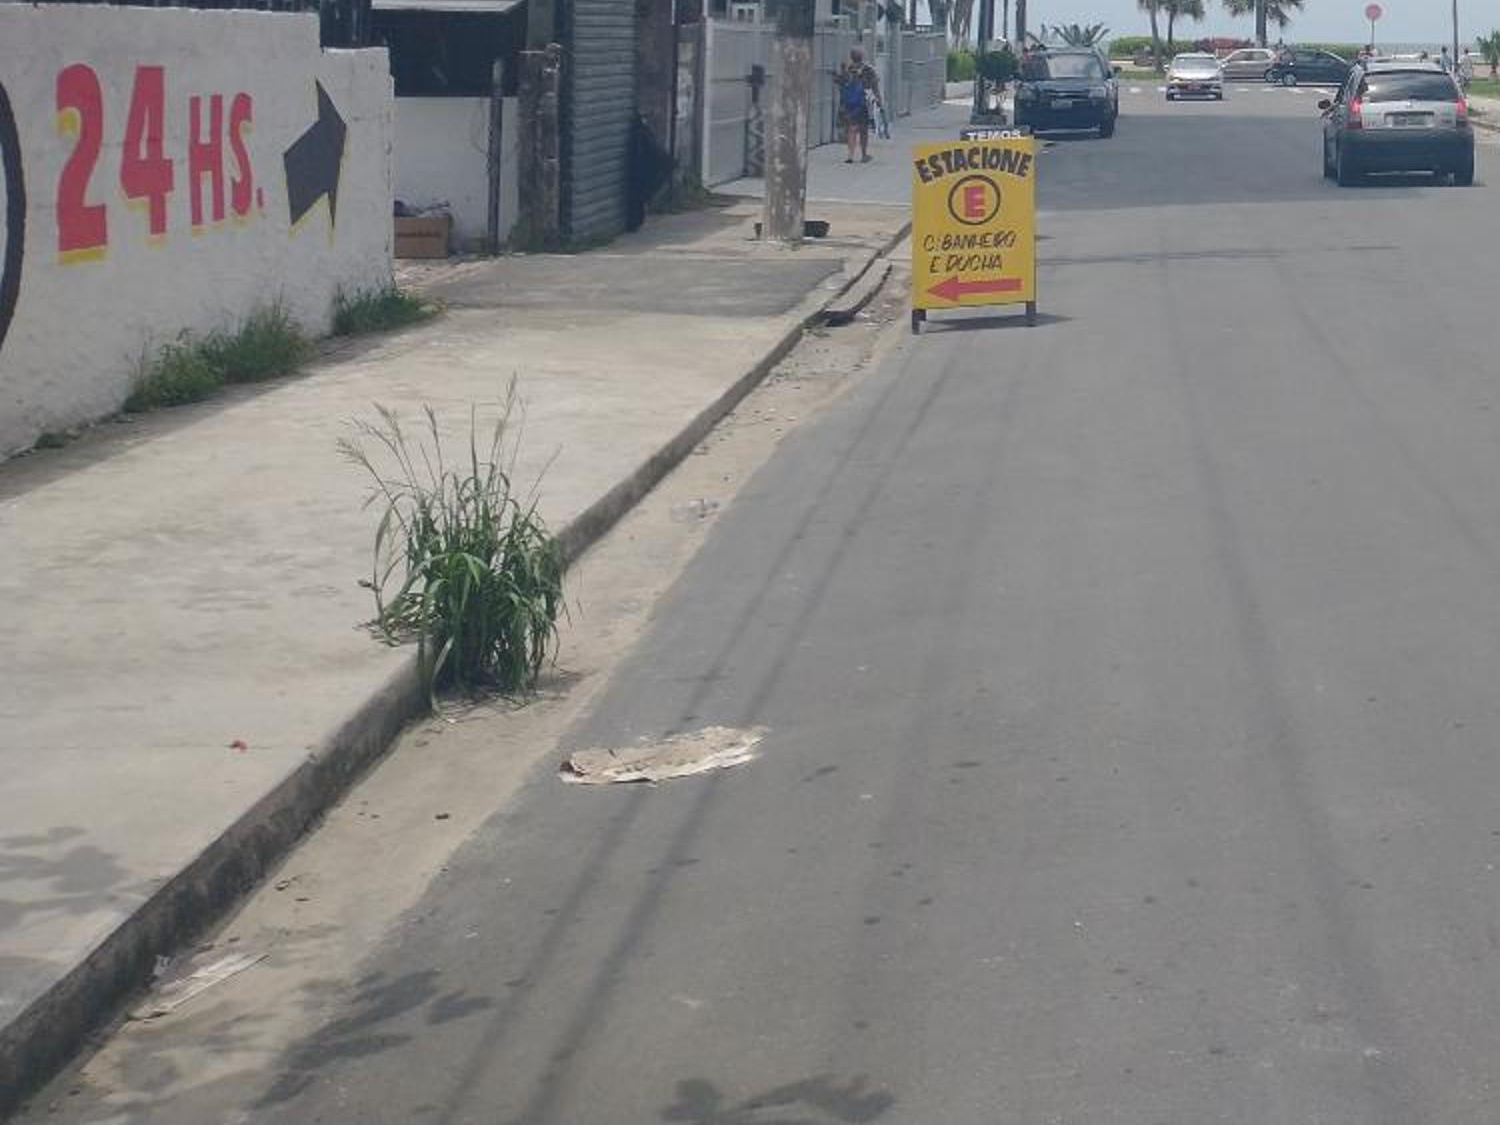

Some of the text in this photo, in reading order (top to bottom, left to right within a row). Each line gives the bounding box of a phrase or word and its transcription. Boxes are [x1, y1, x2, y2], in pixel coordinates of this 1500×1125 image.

[55, 63, 264, 253] 24 HS.
[914, 146, 1033, 184] ESTACIONE
[962, 186, 986, 218] E
[929, 253, 1004, 274] E DUCHA
